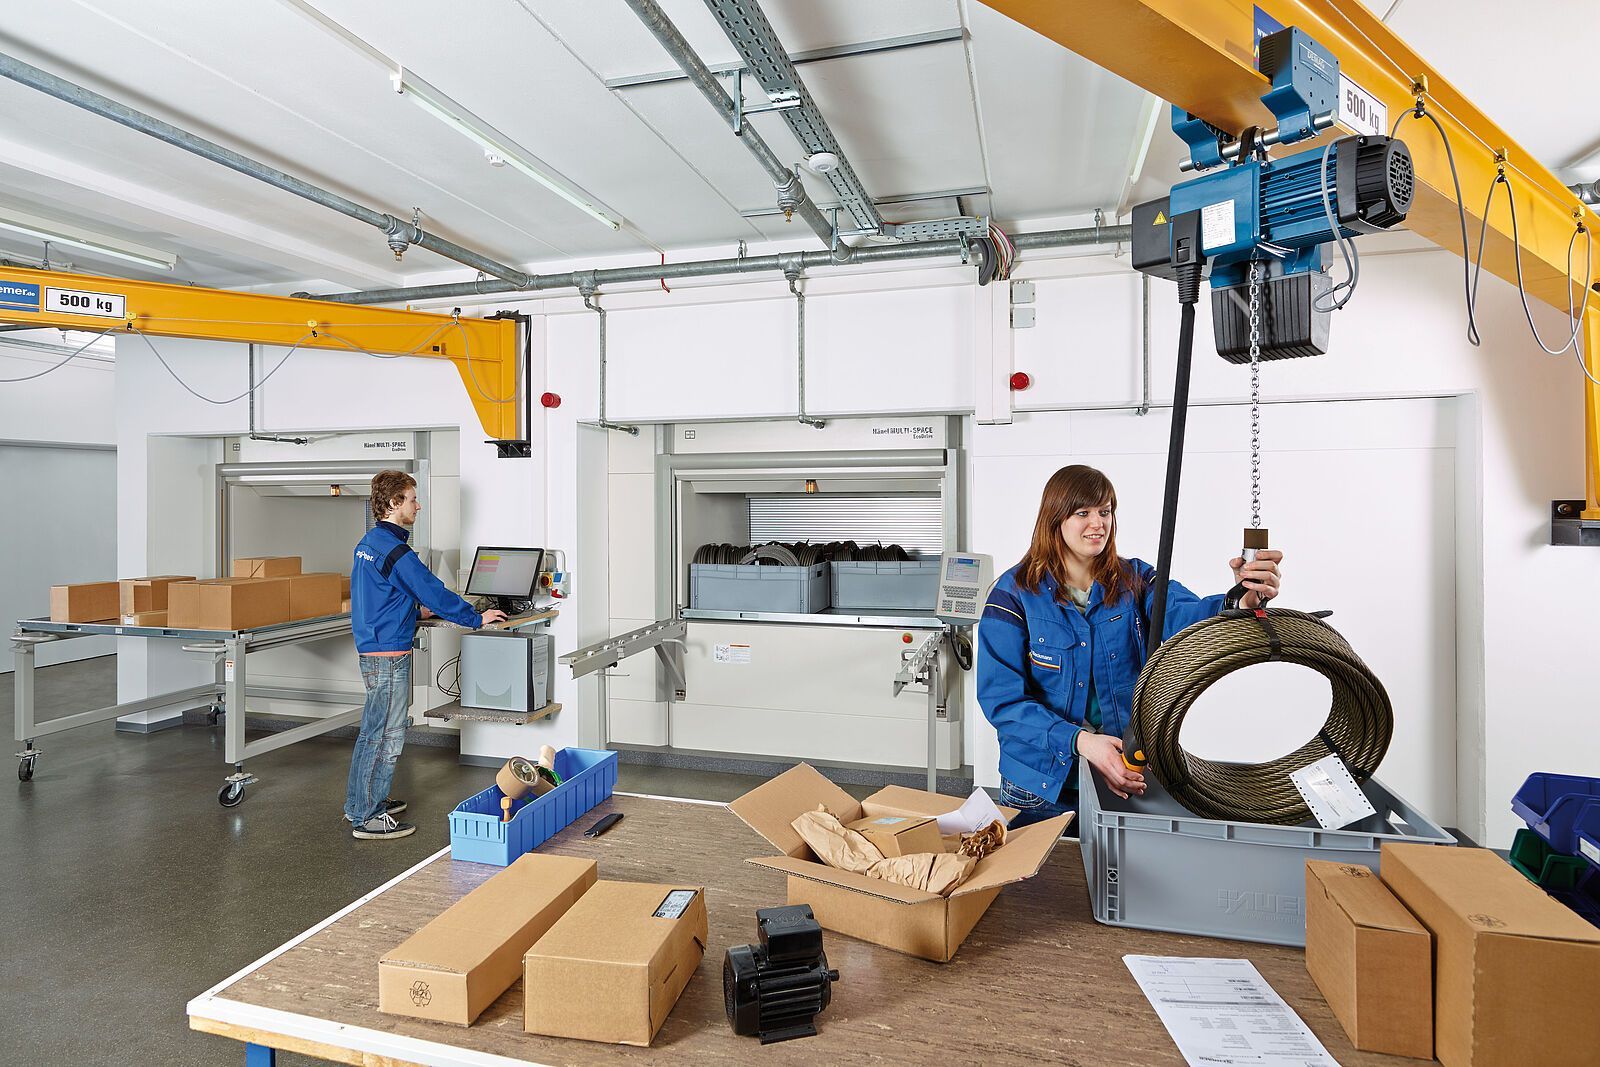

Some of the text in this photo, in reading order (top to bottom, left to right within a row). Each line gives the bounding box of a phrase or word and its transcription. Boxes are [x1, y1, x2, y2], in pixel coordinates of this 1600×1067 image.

[1347, 89, 1380, 136] 500 kg
[60, 293, 112, 312] 500 kg
